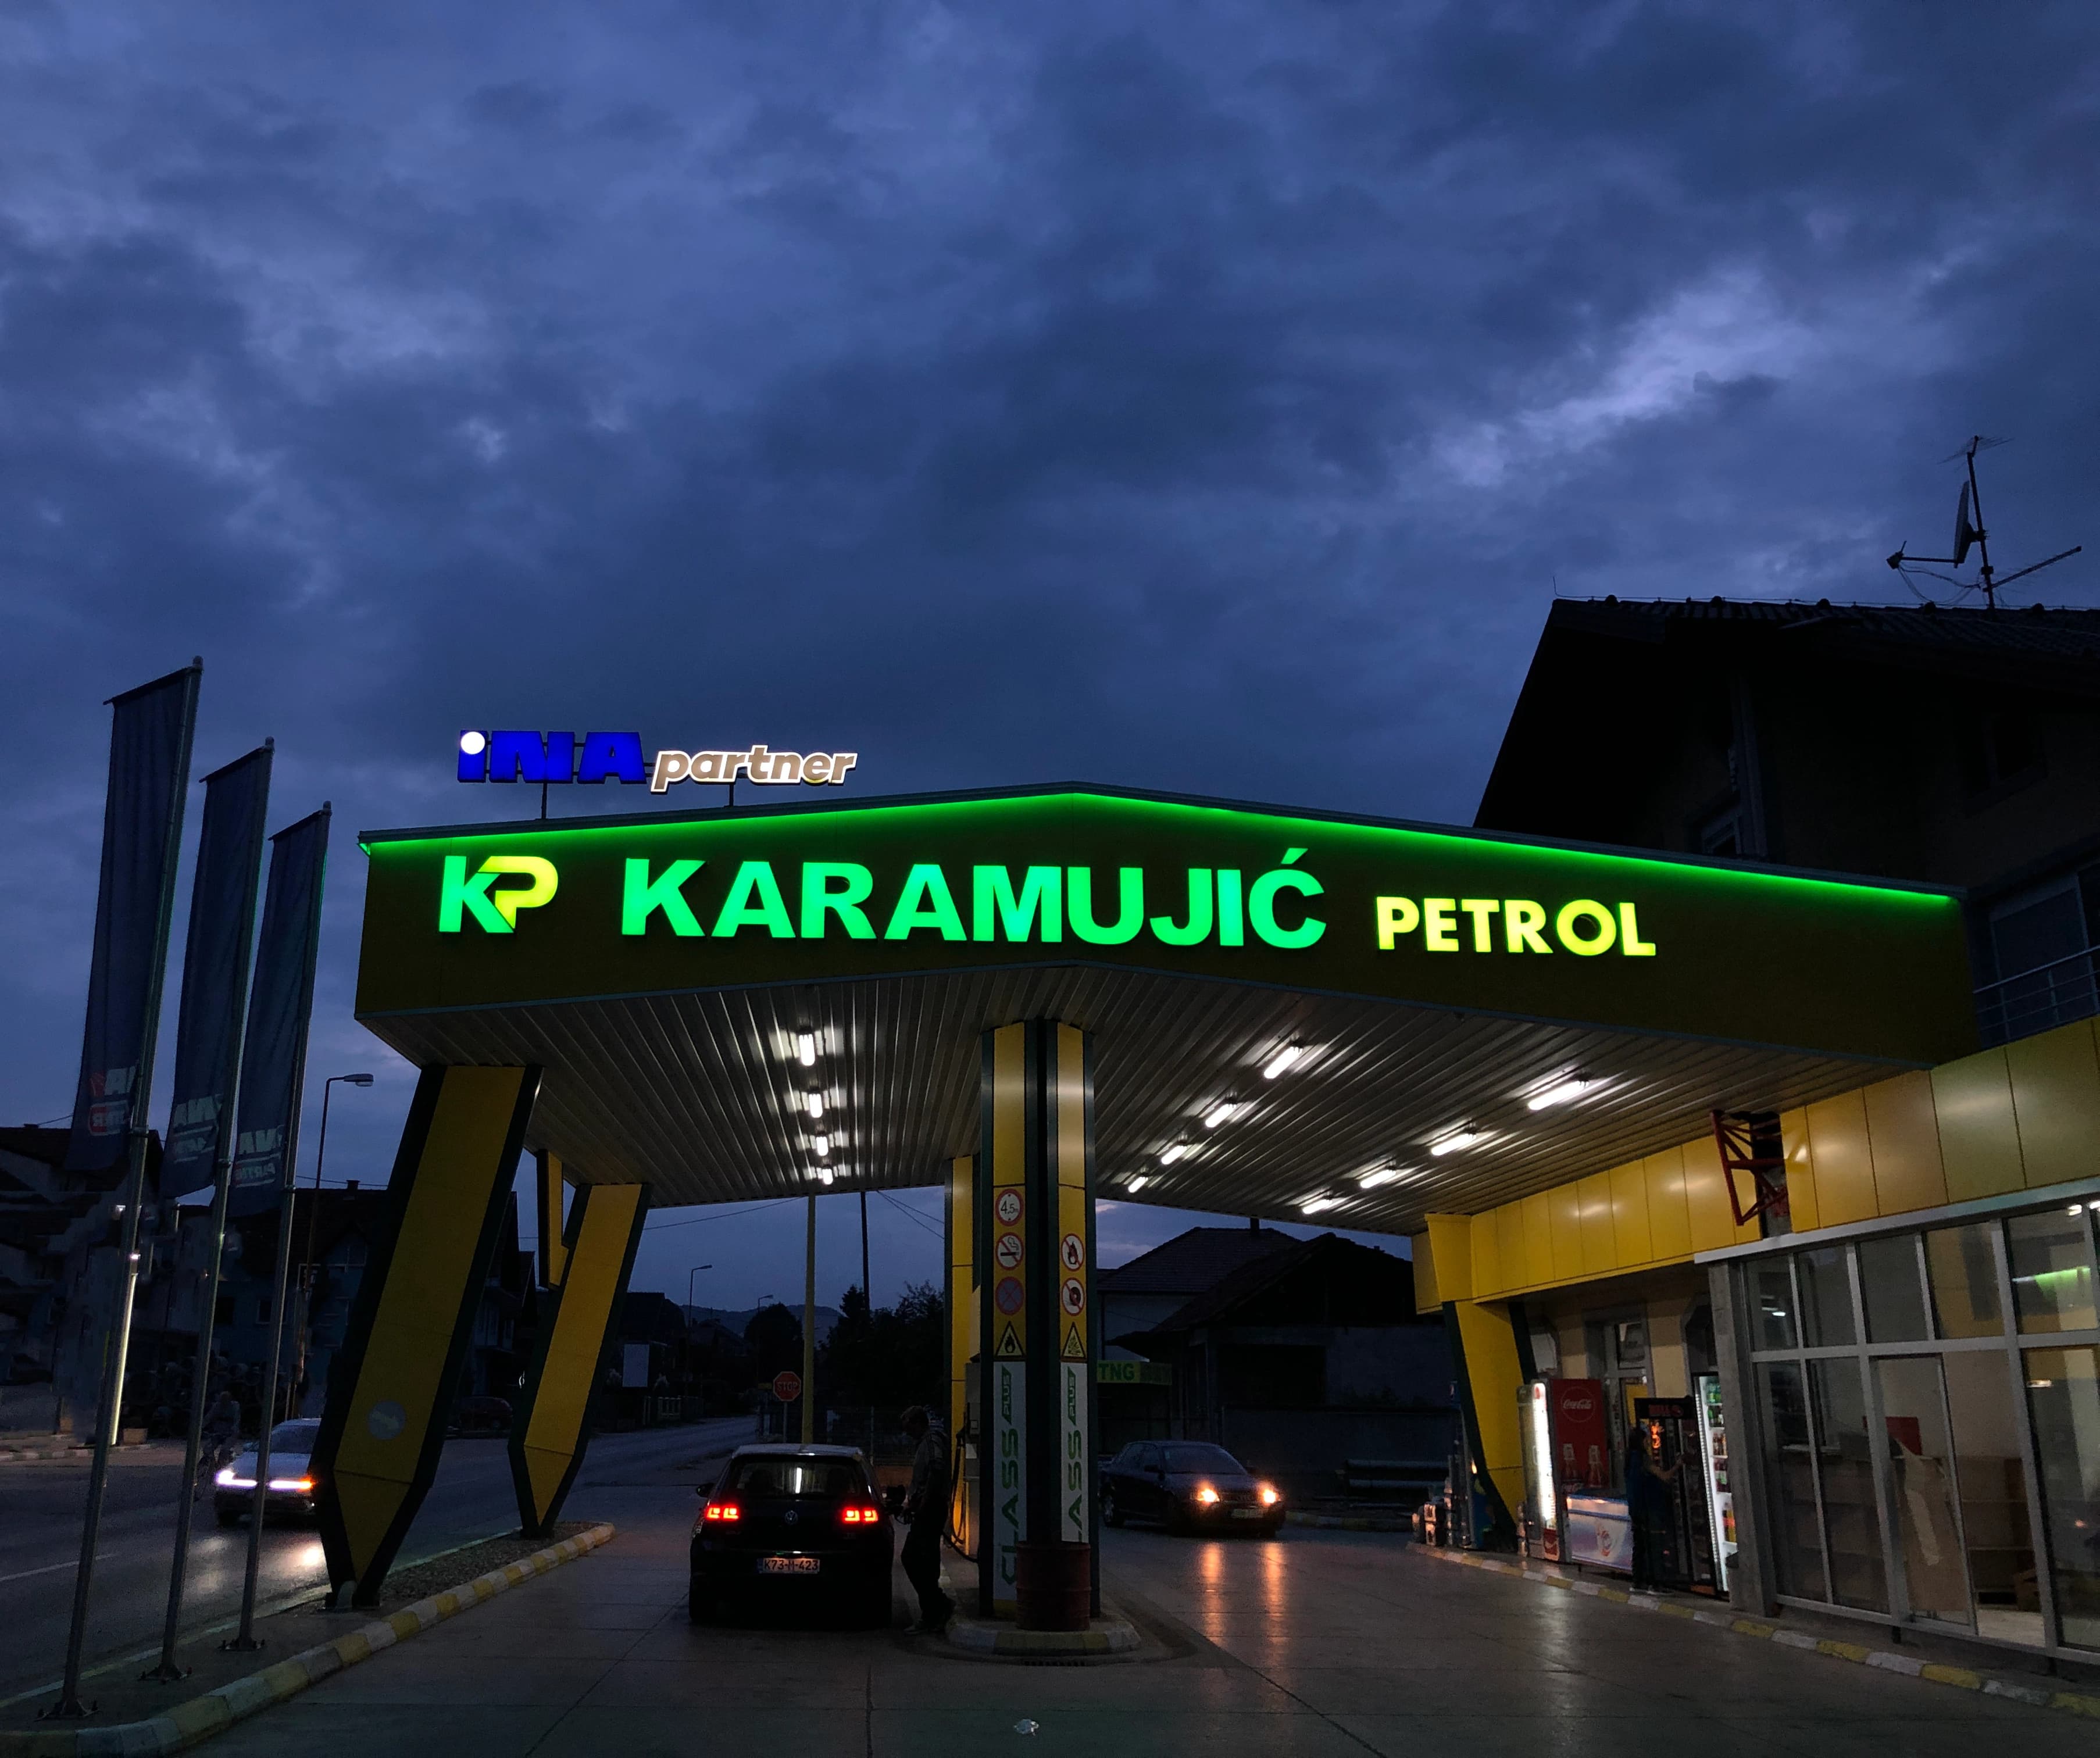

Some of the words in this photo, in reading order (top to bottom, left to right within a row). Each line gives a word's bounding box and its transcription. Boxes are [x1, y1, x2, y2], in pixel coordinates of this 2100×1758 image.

[651, 745, 858, 792] partner
[438, 855, 559, 933] KP
[622, 848, 1327, 949] KARAMUJIĆ
[1376, 896, 1656, 956] PETROL
[777, 1380, 799, 1391] STOP
[1098, 1363, 1135, 1381] TNG
[1001, 1428, 1019, 1585] CLASS
